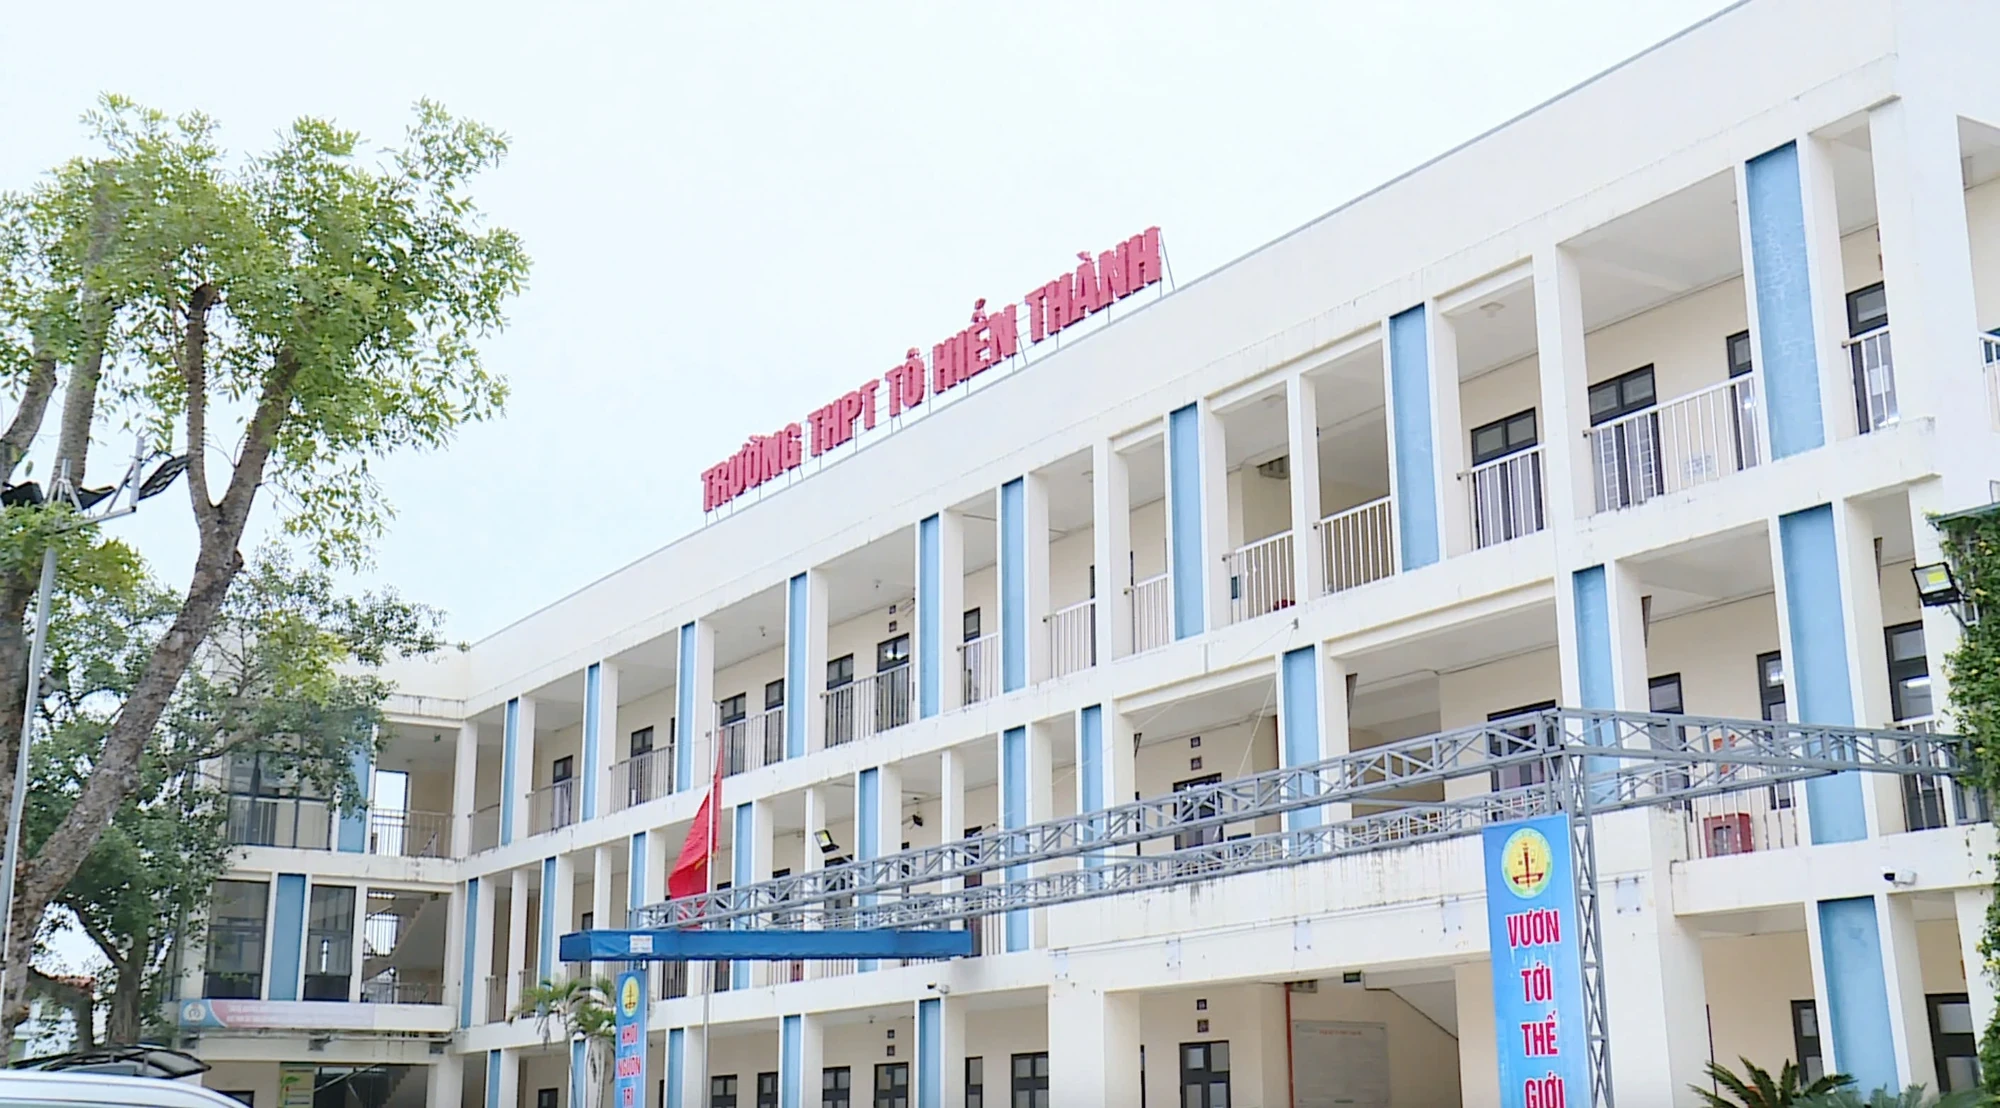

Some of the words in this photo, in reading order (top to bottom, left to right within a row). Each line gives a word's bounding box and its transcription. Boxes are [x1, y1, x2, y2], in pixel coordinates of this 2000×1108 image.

[701, 423, 802, 512] TRƯỜNG
[807, 379, 880, 457] THPT
[885, 347, 925, 417] TÔ
[1025, 226, 1162, 344] THÀNH
[1506, 908, 1560, 948] VƯƠN
[1521, 962, 1553, 1003] TỚI
[1521, 1011, 1558, 1056] THẾ
[1524, 1072, 1565, 1108] GIỚI
